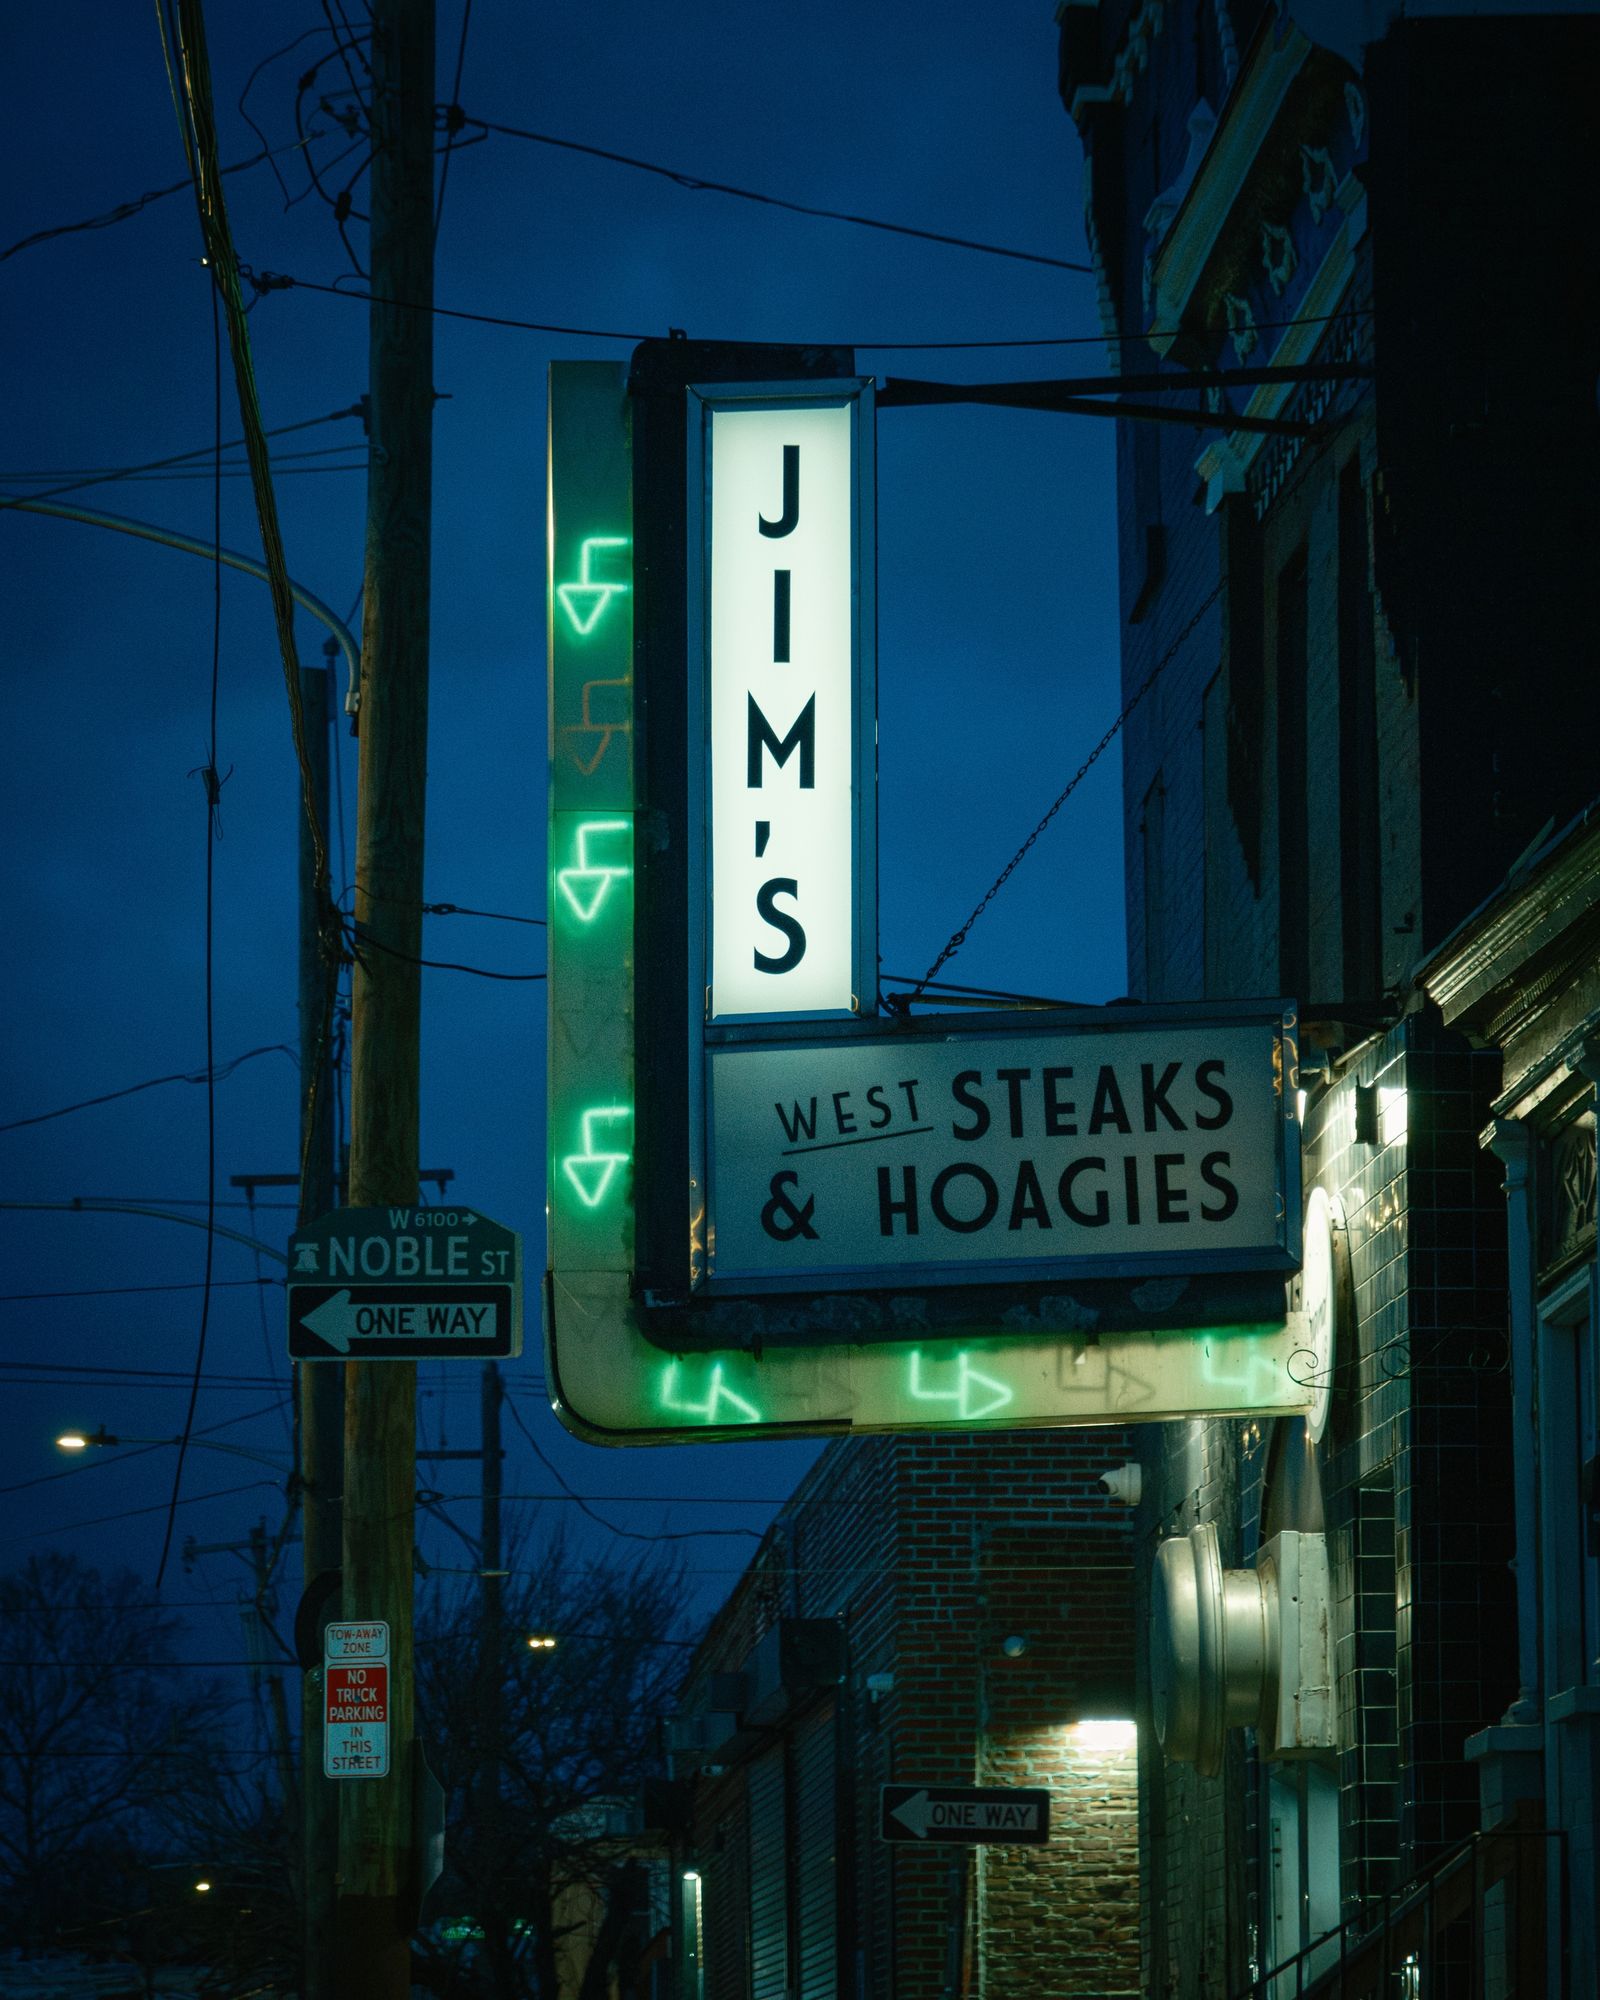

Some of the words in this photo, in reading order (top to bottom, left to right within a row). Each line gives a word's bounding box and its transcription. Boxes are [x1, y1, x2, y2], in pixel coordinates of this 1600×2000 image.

[747, 445, 816, 975] JIM'S
[775, 1080, 920, 1144] WEST
[951, 1060, 1233, 1142] STEAKS
[760, 1170, 820, 1241] &
[877, 1151, 1239, 1236] HOAGIES
[388, 1209, 410, 1230] W
[415, 1212, 459, 1227] 6100
[329, 1236, 469, 1276] NOBLE
[481, 1250, 510, 1276] ST
[356, 1307, 415, 1335] ONE
[426, 1307, 488, 1334] WAY
[330, 1628, 384, 1640] TOW-AWAY
[343, 1643, 371, 1654] ZONE
[347, 1670, 367, 1684] NO
[336, 1688, 378, 1703] TRUCK
[329, 1706, 384, 1721] PARKING
[351, 1727, 363, 1737] IN
[342, 1741, 372, 1753] THIS
[333, 1756, 381, 1770] STREET
[932, 1804, 976, 1825] ONE
[986, 1806, 1031, 1827] WAY
